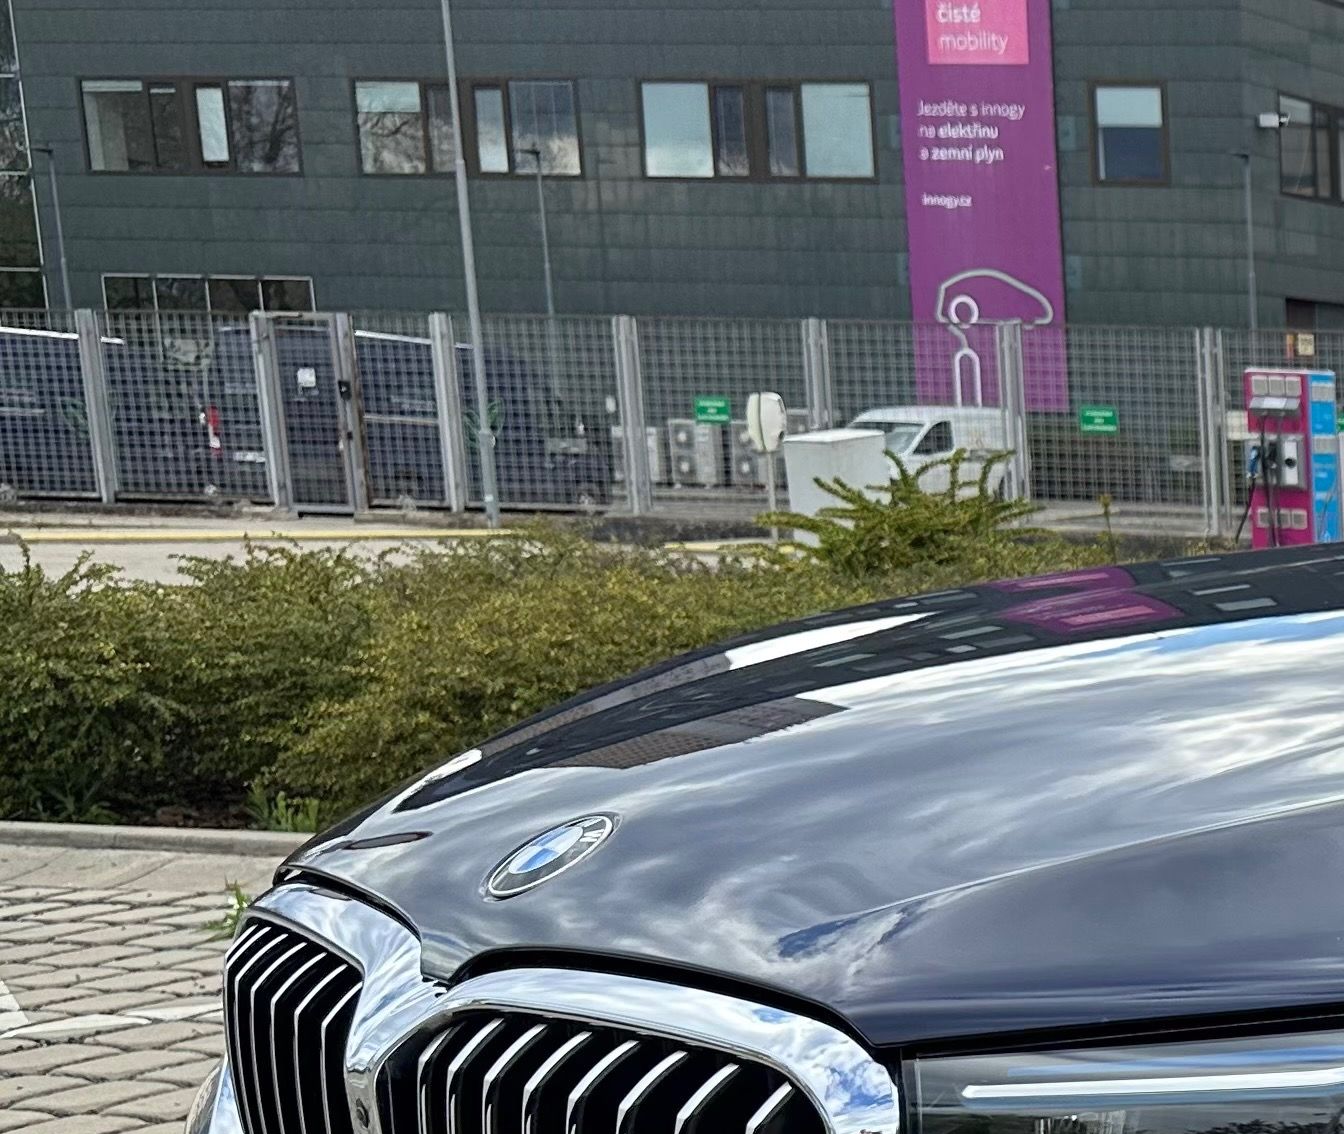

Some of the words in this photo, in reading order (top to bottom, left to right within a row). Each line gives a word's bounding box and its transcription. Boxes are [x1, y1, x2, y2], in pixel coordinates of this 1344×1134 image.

[937, 2, 980, 23] čisté
[939, 31, 1008, 54] mobility
[918, 100, 967, 117] Jezděte
[970, 103, 978, 116] s
[981, 101, 1025, 120] innogy
[919, 124, 936, 138] na
[938, 121, 998, 138] elektřinu
[921, 147, 929, 160] a
[931, 143, 972, 160] zemní
[975, 143, 1004, 164] plyn
[922, 192, 971, 209] innogy.cz
